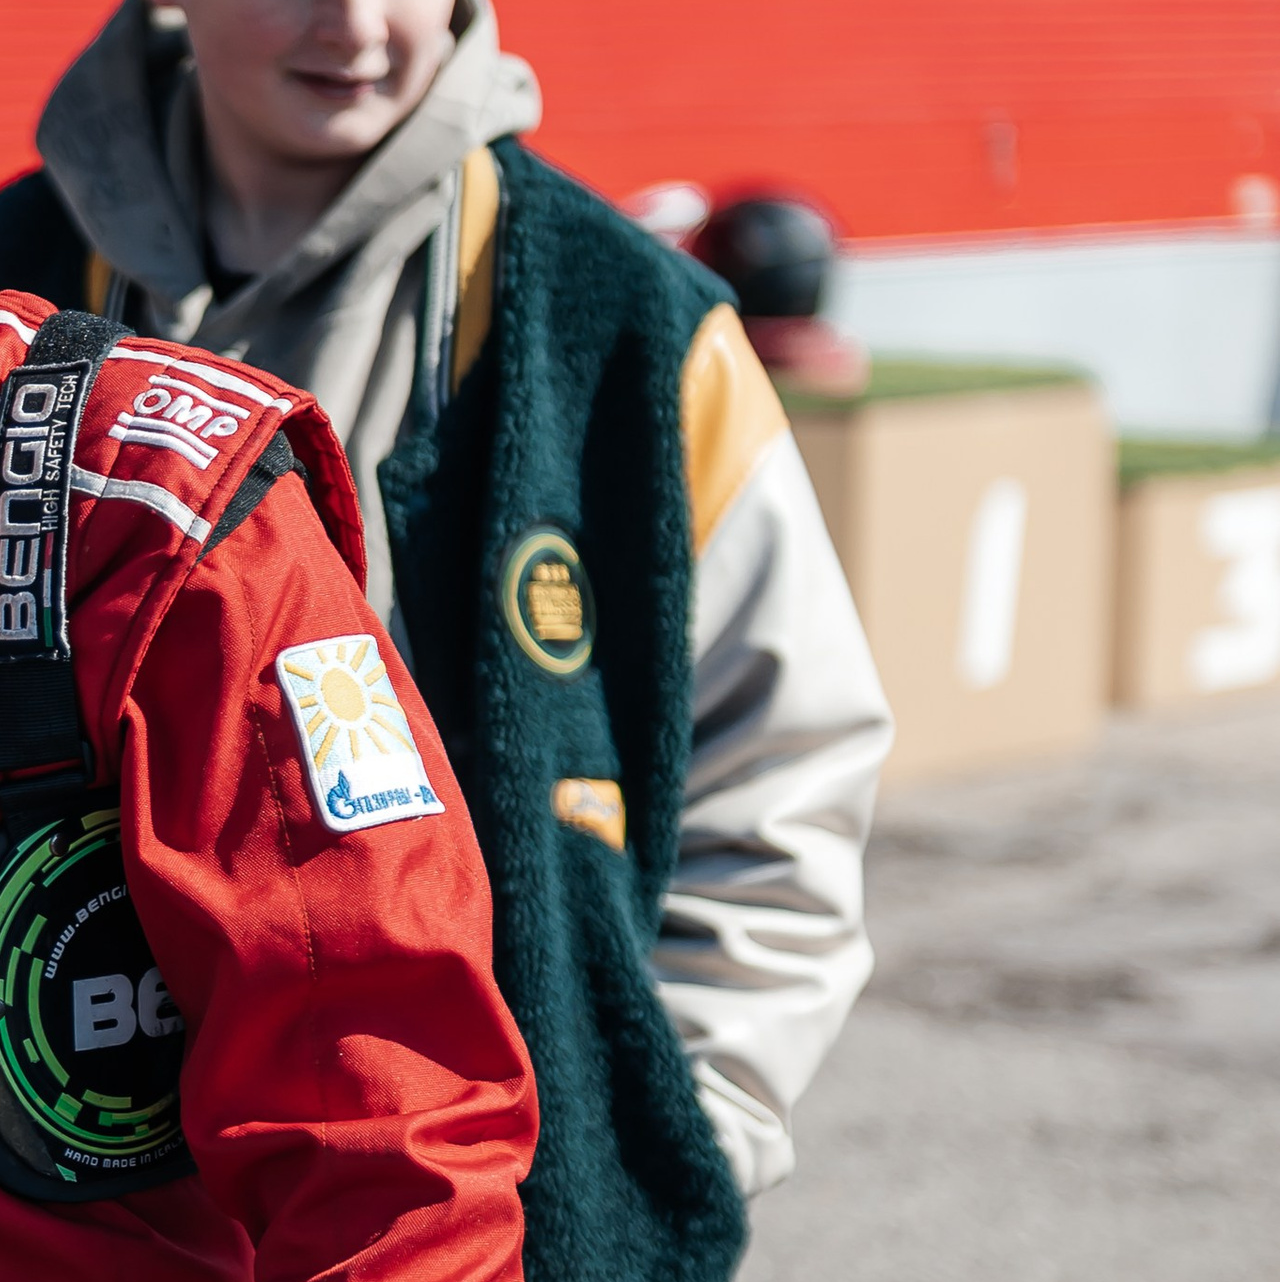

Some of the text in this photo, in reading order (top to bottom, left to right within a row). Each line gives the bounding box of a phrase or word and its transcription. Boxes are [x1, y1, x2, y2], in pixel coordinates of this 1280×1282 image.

[133, 388, 239, 439] OMP
[41, 374, 78, 531] HIGH SAFETY TECH
[64, 1148, 99, 1167] HAND
[102, 1157, 137, 1168] MADE
[140, 1153, 151, 1165] IN
